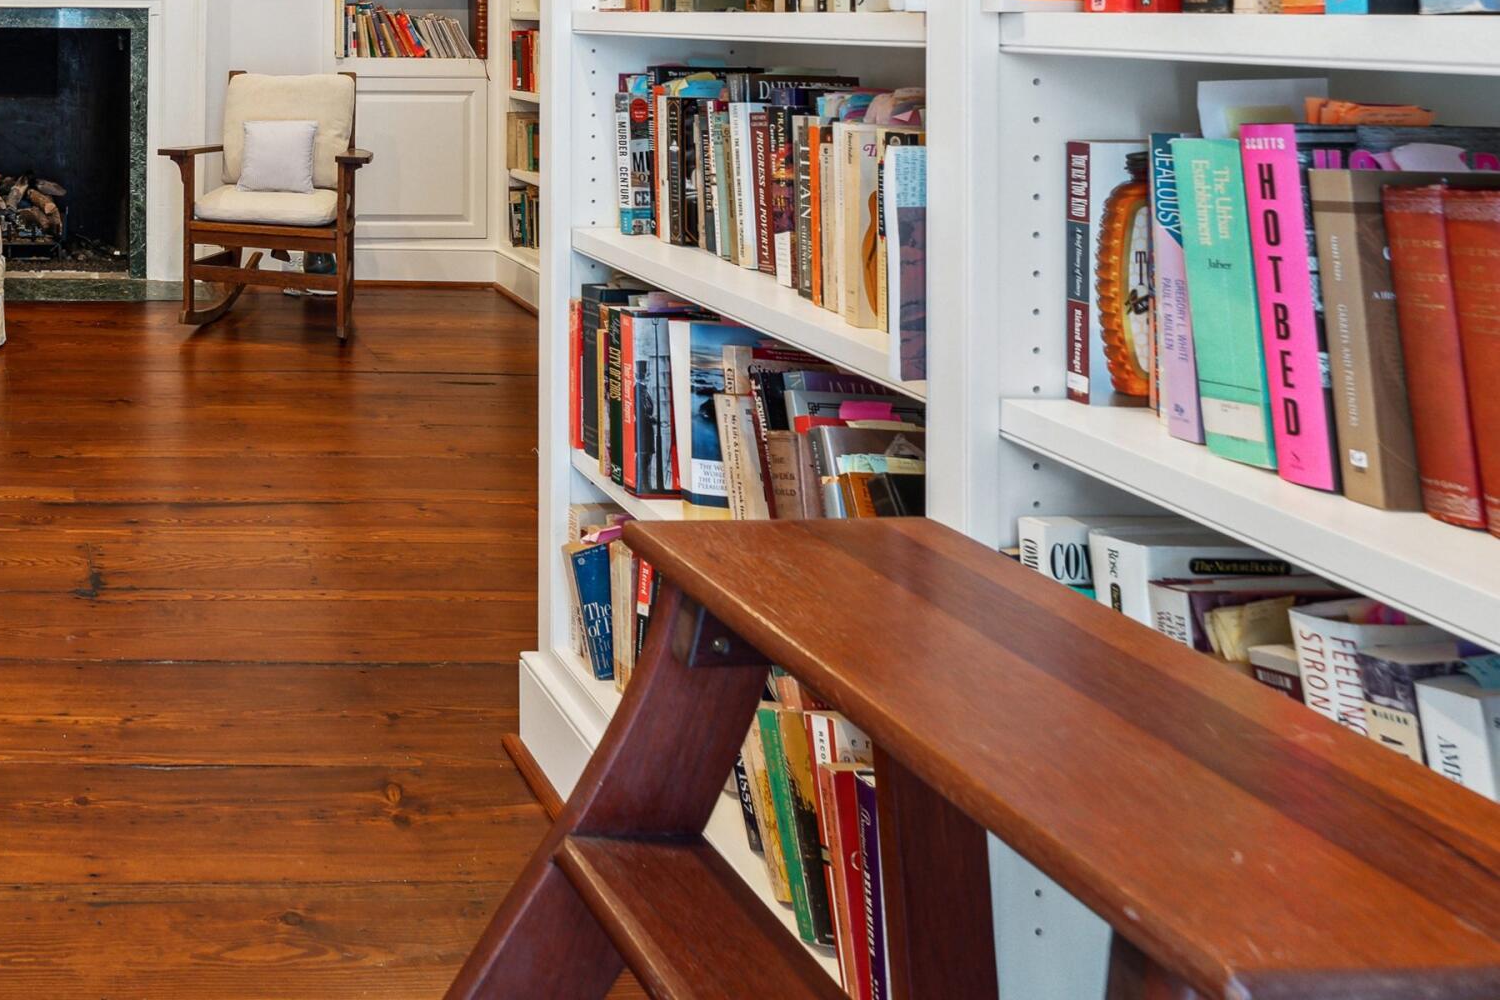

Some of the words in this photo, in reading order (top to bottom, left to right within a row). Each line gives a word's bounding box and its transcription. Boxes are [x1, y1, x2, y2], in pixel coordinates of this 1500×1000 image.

[617, 121, 627, 157] MURDER
[776, 112, 785, 154] PRAIRIE
[755, 130, 765, 187] PROGRESS
[1071, 154, 1088, 179] YOU'RE
[619, 166, 630, 206] CENTURY
[800, 143, 812, 219] TITAN
[1071, 181, 1087, 196] TOO
[1154, 148, 1181, 234] JEALOUSY
[1213, 166, 1229, 191] The
[758, 187, 766, 206] and
[1071, 197, 1087, 218] KIND
[1192, 159, 1212, 246] Establishment
[760, 207, 771, 259] POVERTY
[1216, 197, 1231, 241] Urban
[1163, 278, 1172, 299] PAUL
[1174, 280, 1185, 322] GREGORY
[1257, 163, 1301, 437] HOTBED
[1073, 309, 1083, 340] Richard
[1164, 313, 1174, 351] MULLEN
[1336, 303, 1348, 344] GARRETS
[609, 346, 621, 368] CITY
[1072, 341, 1082, 373] Stengel
[1178, 333, 1187, 362] WHITE
[1340, 346, 1351, 368] AND
[609, 367, 621, 379] OF
[727, 368, 735, 393] City
[610, 378, 621, 401] EROS
[1344, 370, 1358, 427] PRETENDERS
[1107, 548, 1119, 577] Rose
[641, 567, 651, 597] Record
[584, 601, 611, 620] The
[588, 616, 600, 638] of
[740, 774, 753, 815] 1857
[864, 870, 876, 957] DELMONICO'S
